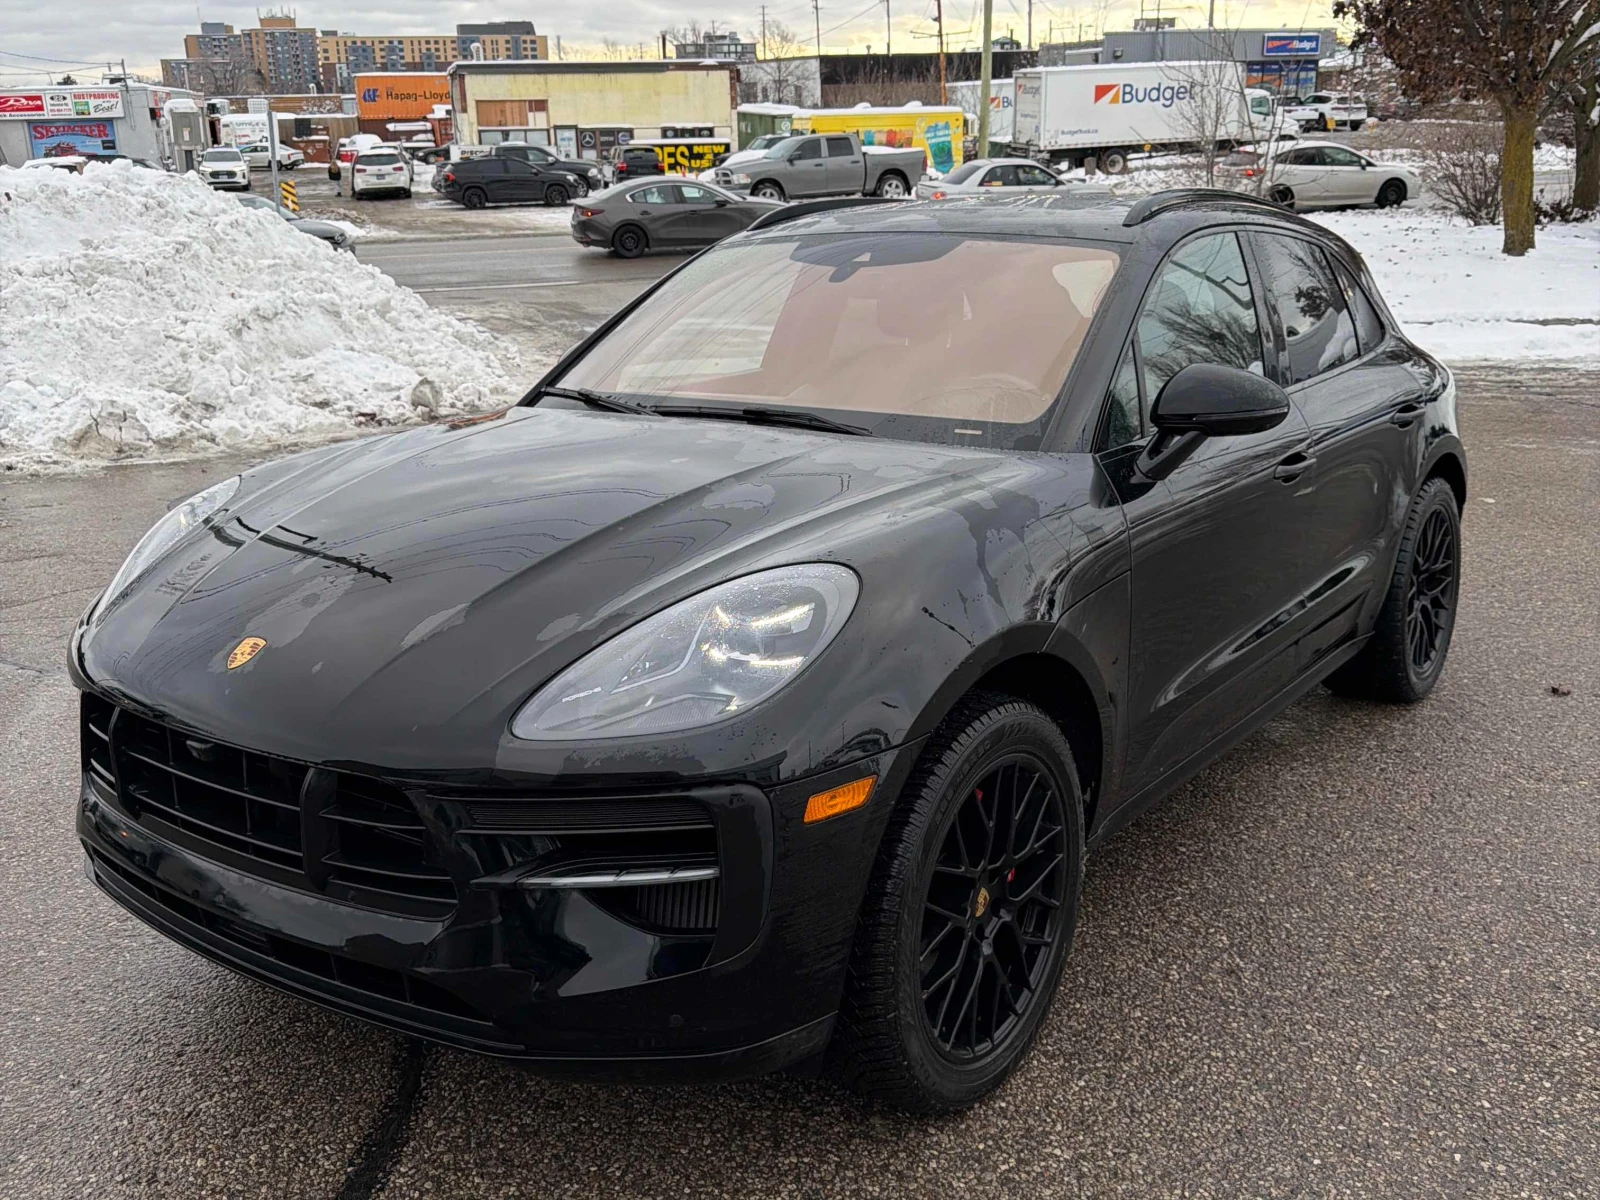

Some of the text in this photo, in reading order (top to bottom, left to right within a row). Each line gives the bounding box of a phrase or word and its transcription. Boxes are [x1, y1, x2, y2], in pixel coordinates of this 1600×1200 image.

[1293, 40, 1316, 50] Budget
[73, 92, 119, 100] RUSTPROOFING
[386, 90, 450, 101] Hapag-Lloyd
[1122, 82, 1195, 108] Budget
[93, 101, 119, 113] Best!
[32, 123, 109, 140] SKYJACKER
[693, 145, 725, 154] NEW
